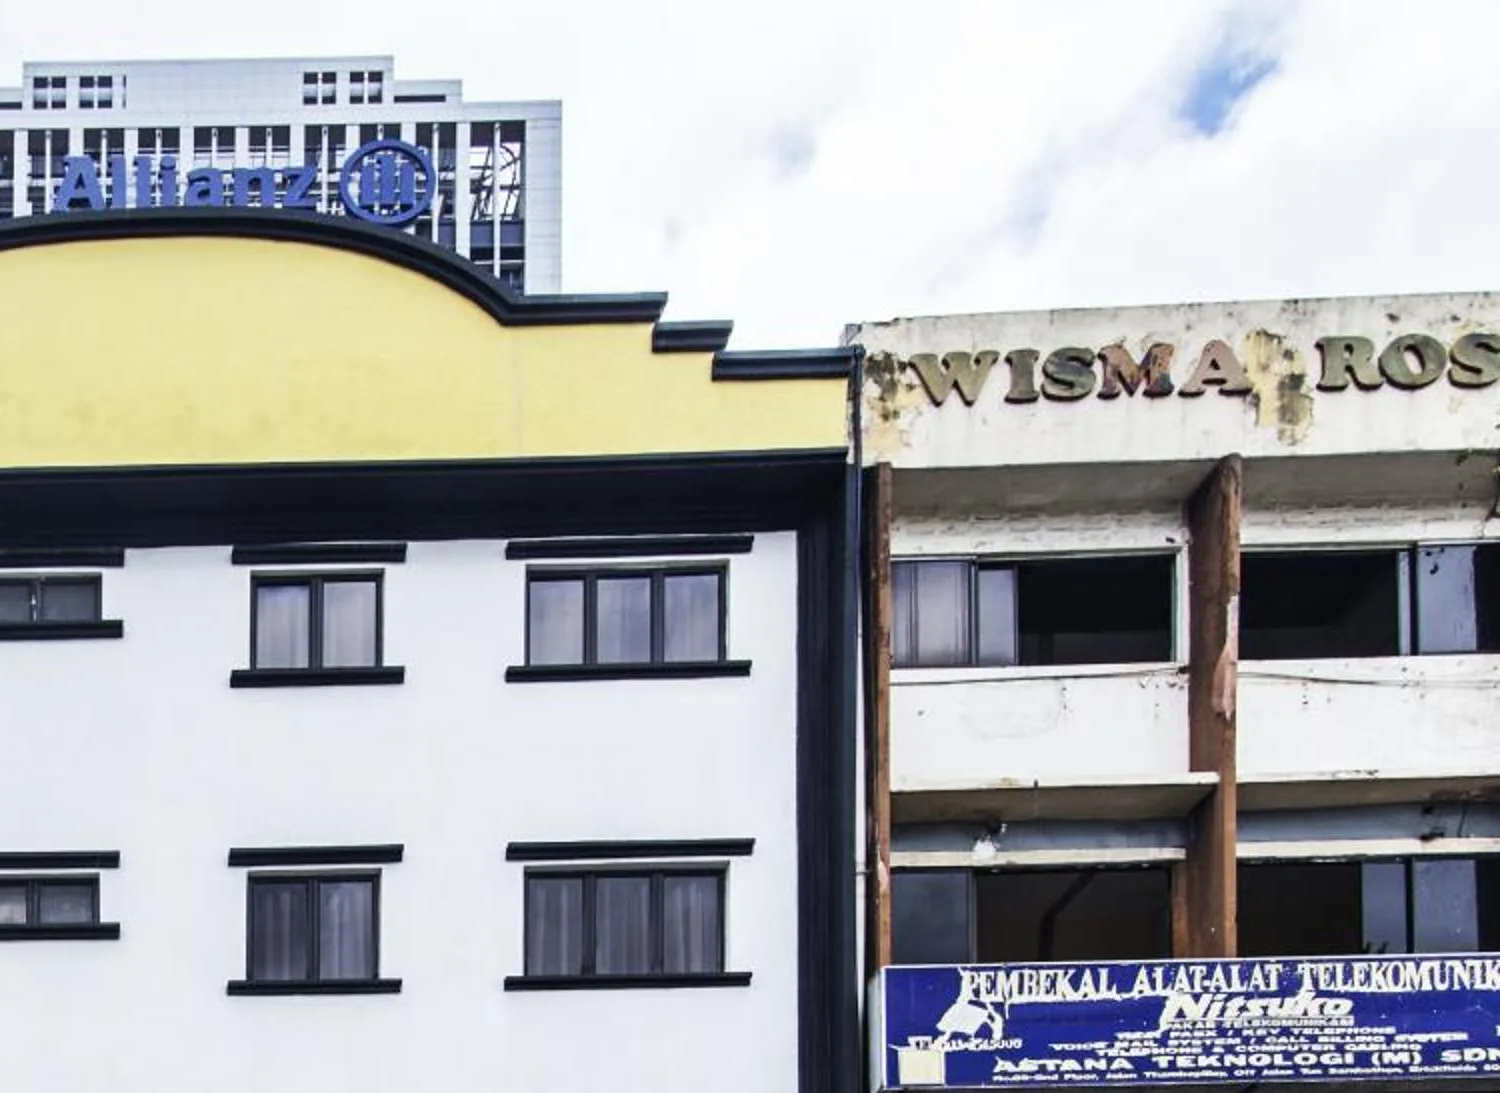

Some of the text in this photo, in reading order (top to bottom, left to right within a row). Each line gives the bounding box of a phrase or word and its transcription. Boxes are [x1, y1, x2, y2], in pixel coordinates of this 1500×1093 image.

[55, 156, 320, 212] Allianz
[907, 333, 1500, 406] WISMA ROS
[961, 959, 1500, 1002] PEMBEKAL ALAT-ALAT TELEKOMUNIK
[1165, 989, 1354, 1019] Nitsuko
[1264, 1036, 1310, 1044] CALL
[993, 1055, 1136, 1074] ASTANA
[1151, 1051, 1355, 1070] TEKNOLOGI
[1370, 1050, 1422, 1067] (M)
